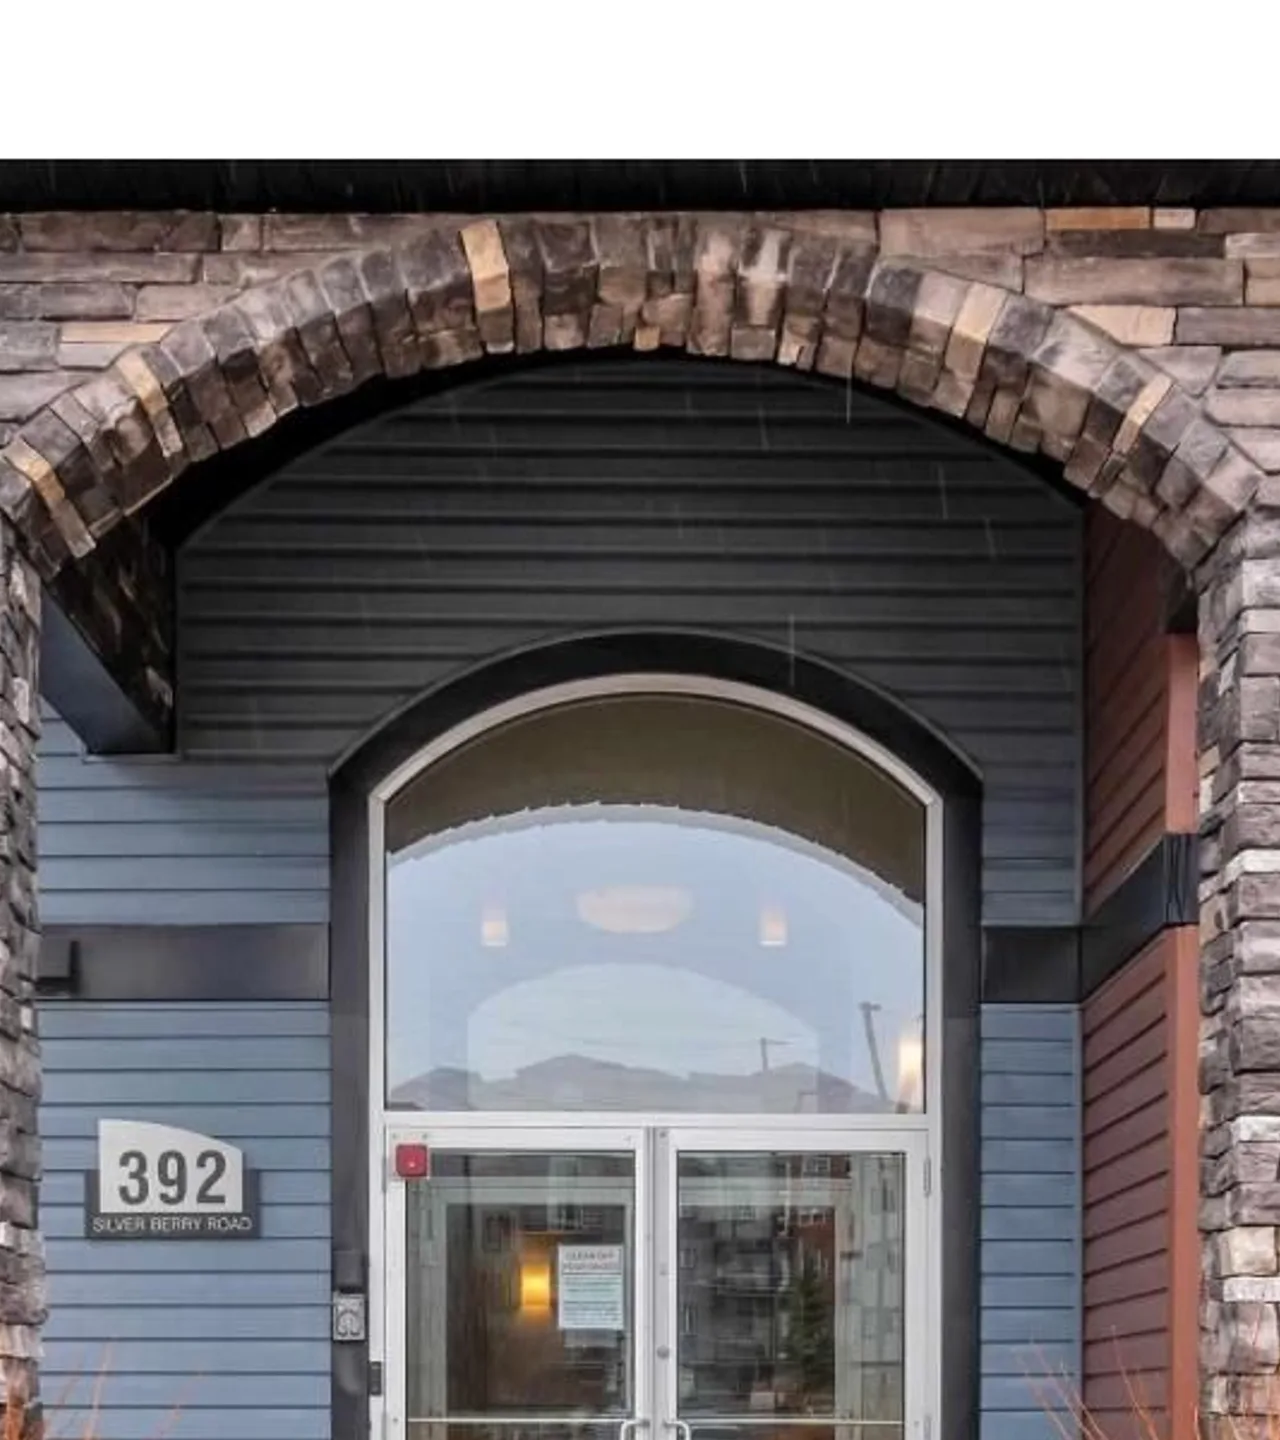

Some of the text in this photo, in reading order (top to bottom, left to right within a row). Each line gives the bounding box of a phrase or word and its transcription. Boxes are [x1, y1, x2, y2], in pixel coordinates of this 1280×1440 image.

[118, 1150, 227, 1205] 392
[93, 1216, 253, 1232] SILVER BERRY ROAD
